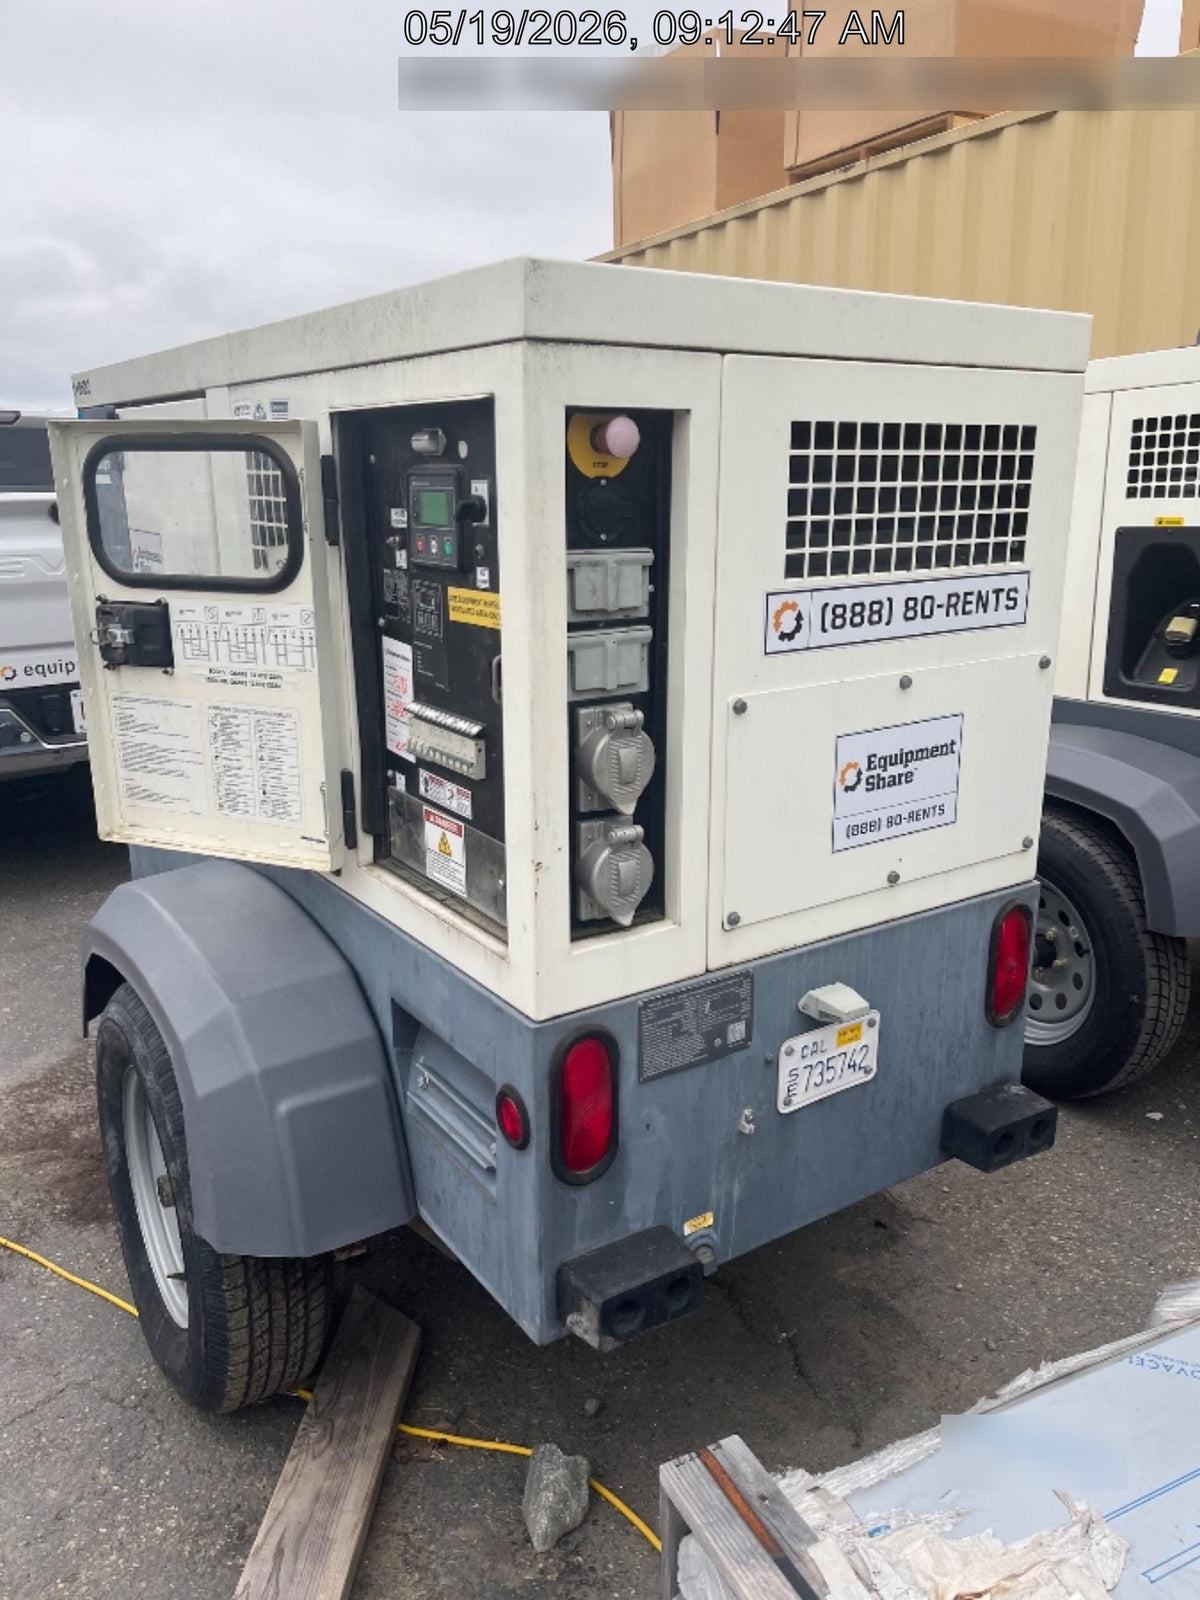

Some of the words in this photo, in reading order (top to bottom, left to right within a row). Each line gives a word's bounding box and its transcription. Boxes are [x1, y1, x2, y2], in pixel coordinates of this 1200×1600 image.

[820, 597, 894, 633] (888)
[903, 586, 1019, 622] 80-RENTS
[24, 659, 76, 678] equip
[865, 739, 957, 772] Equipment
[865, 770, 914, 793] Share
[845, 817, 882, 839] (888)
[886, 803, 945, 829] 80-RENTS
[801, 1040, 828, 1059] CAL
[803, 1044, 872, 1093] 735742
